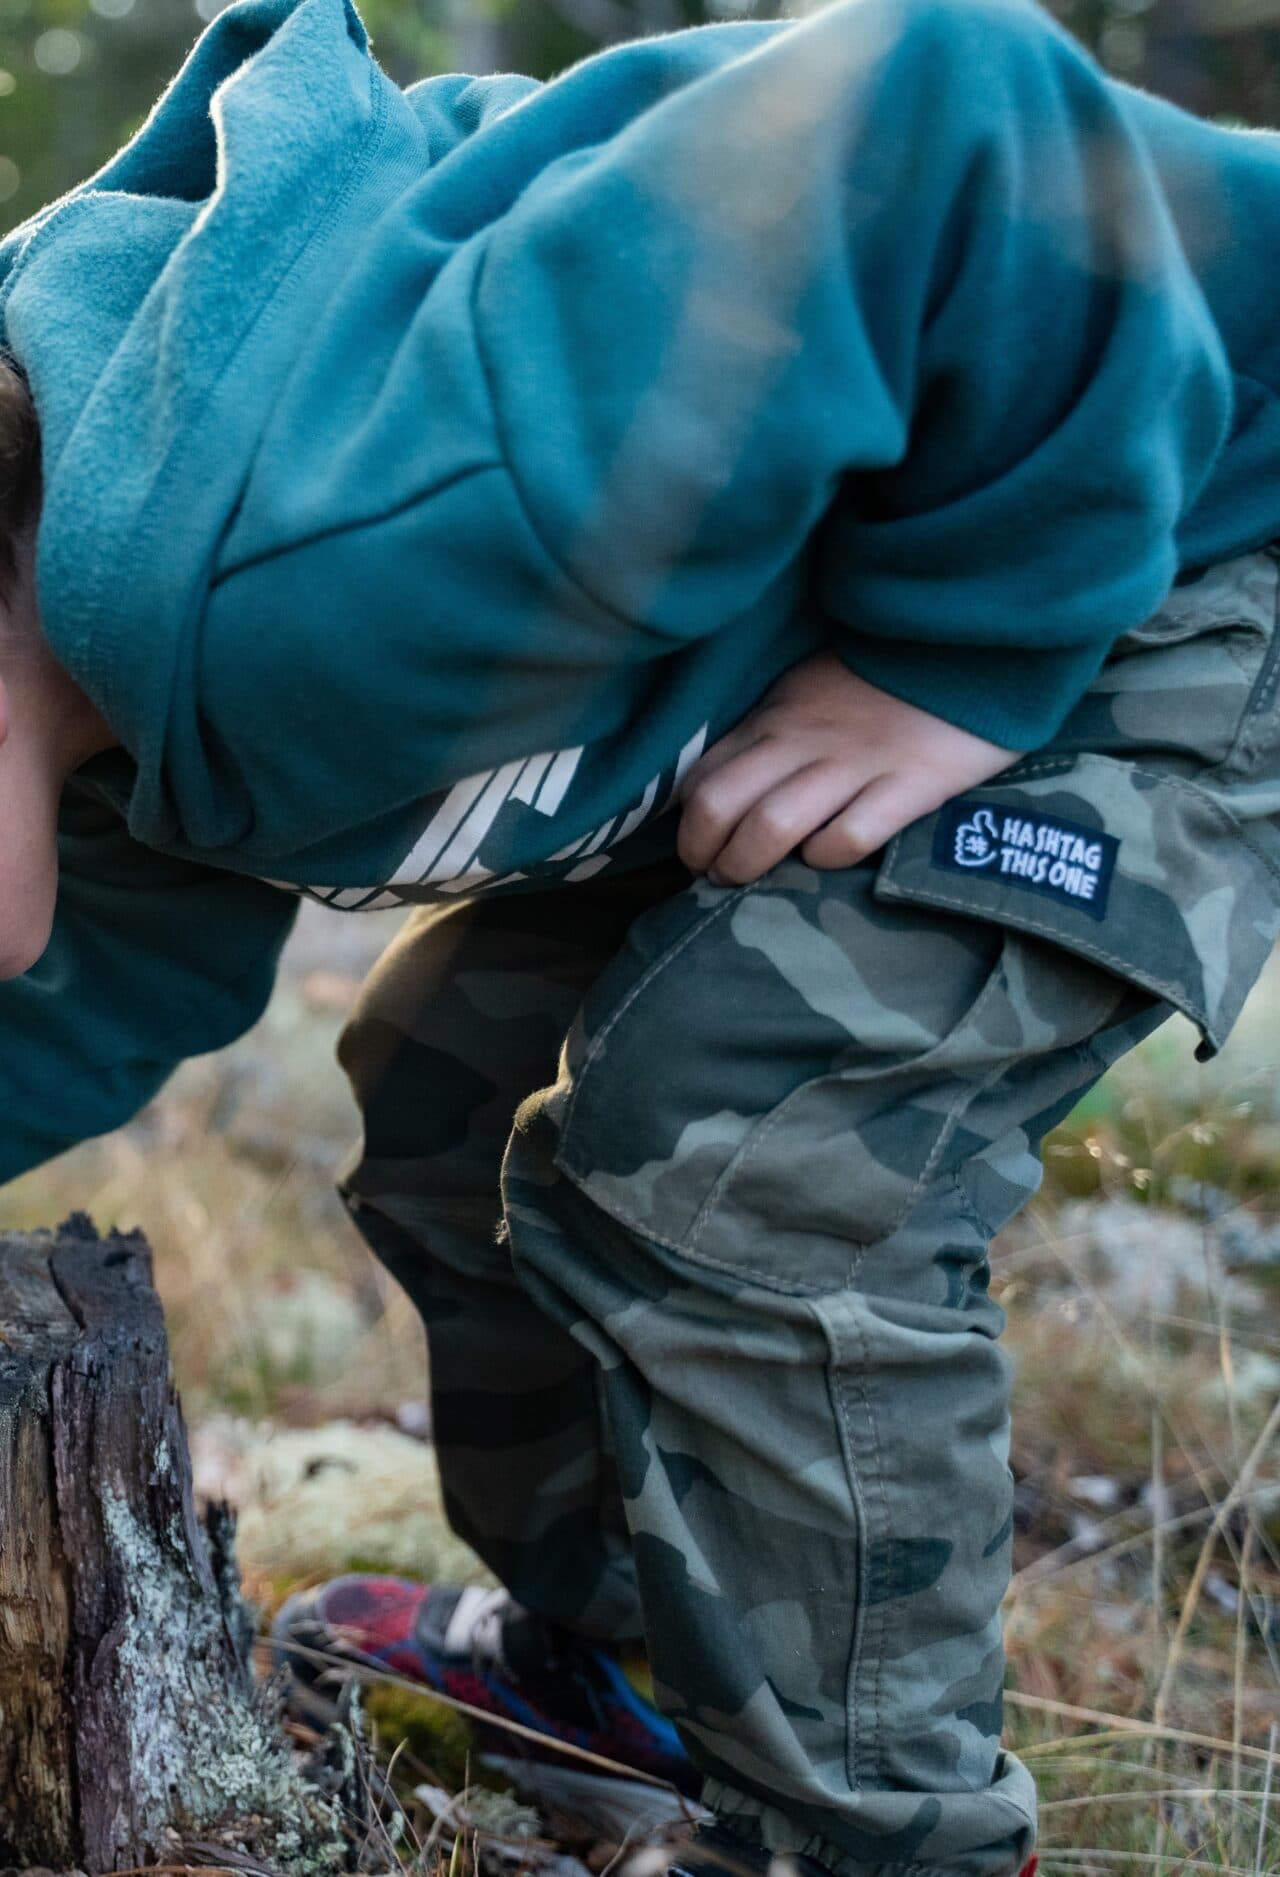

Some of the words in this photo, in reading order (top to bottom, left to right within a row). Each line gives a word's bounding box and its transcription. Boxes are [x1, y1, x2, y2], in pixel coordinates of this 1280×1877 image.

[1001, 818, 1100, 870] HASHTAG
[1001, 849, 1049, 882] THIS
[1049, 862, 1097, 899] ONE
